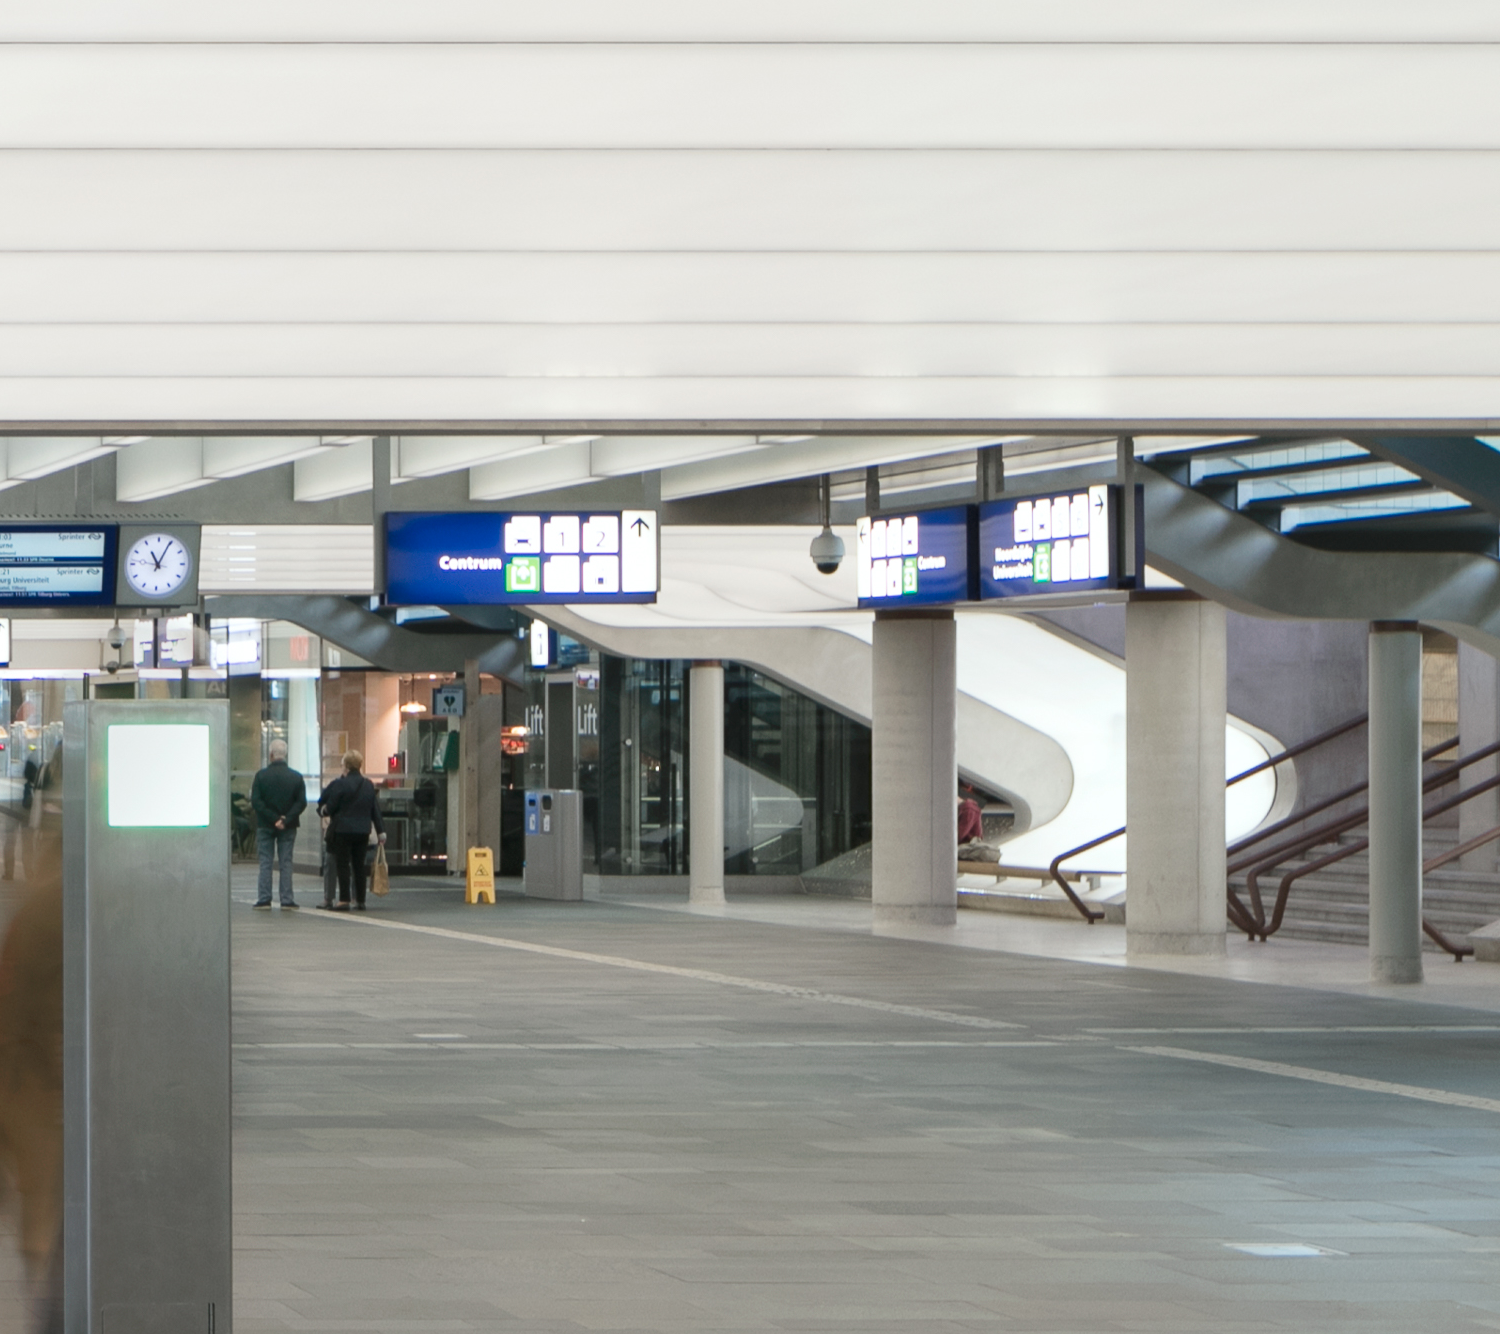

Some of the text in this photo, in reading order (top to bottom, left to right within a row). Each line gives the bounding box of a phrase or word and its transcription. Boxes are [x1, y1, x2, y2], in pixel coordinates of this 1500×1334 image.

[58, 533, 85, 542] Sprinter
[439, 555, 502, 570] Centrum
[56, 568, 83, 577] Sprinter
[525, 704, 544, 735] Lift
[578, 703, 598, 735] Lift
